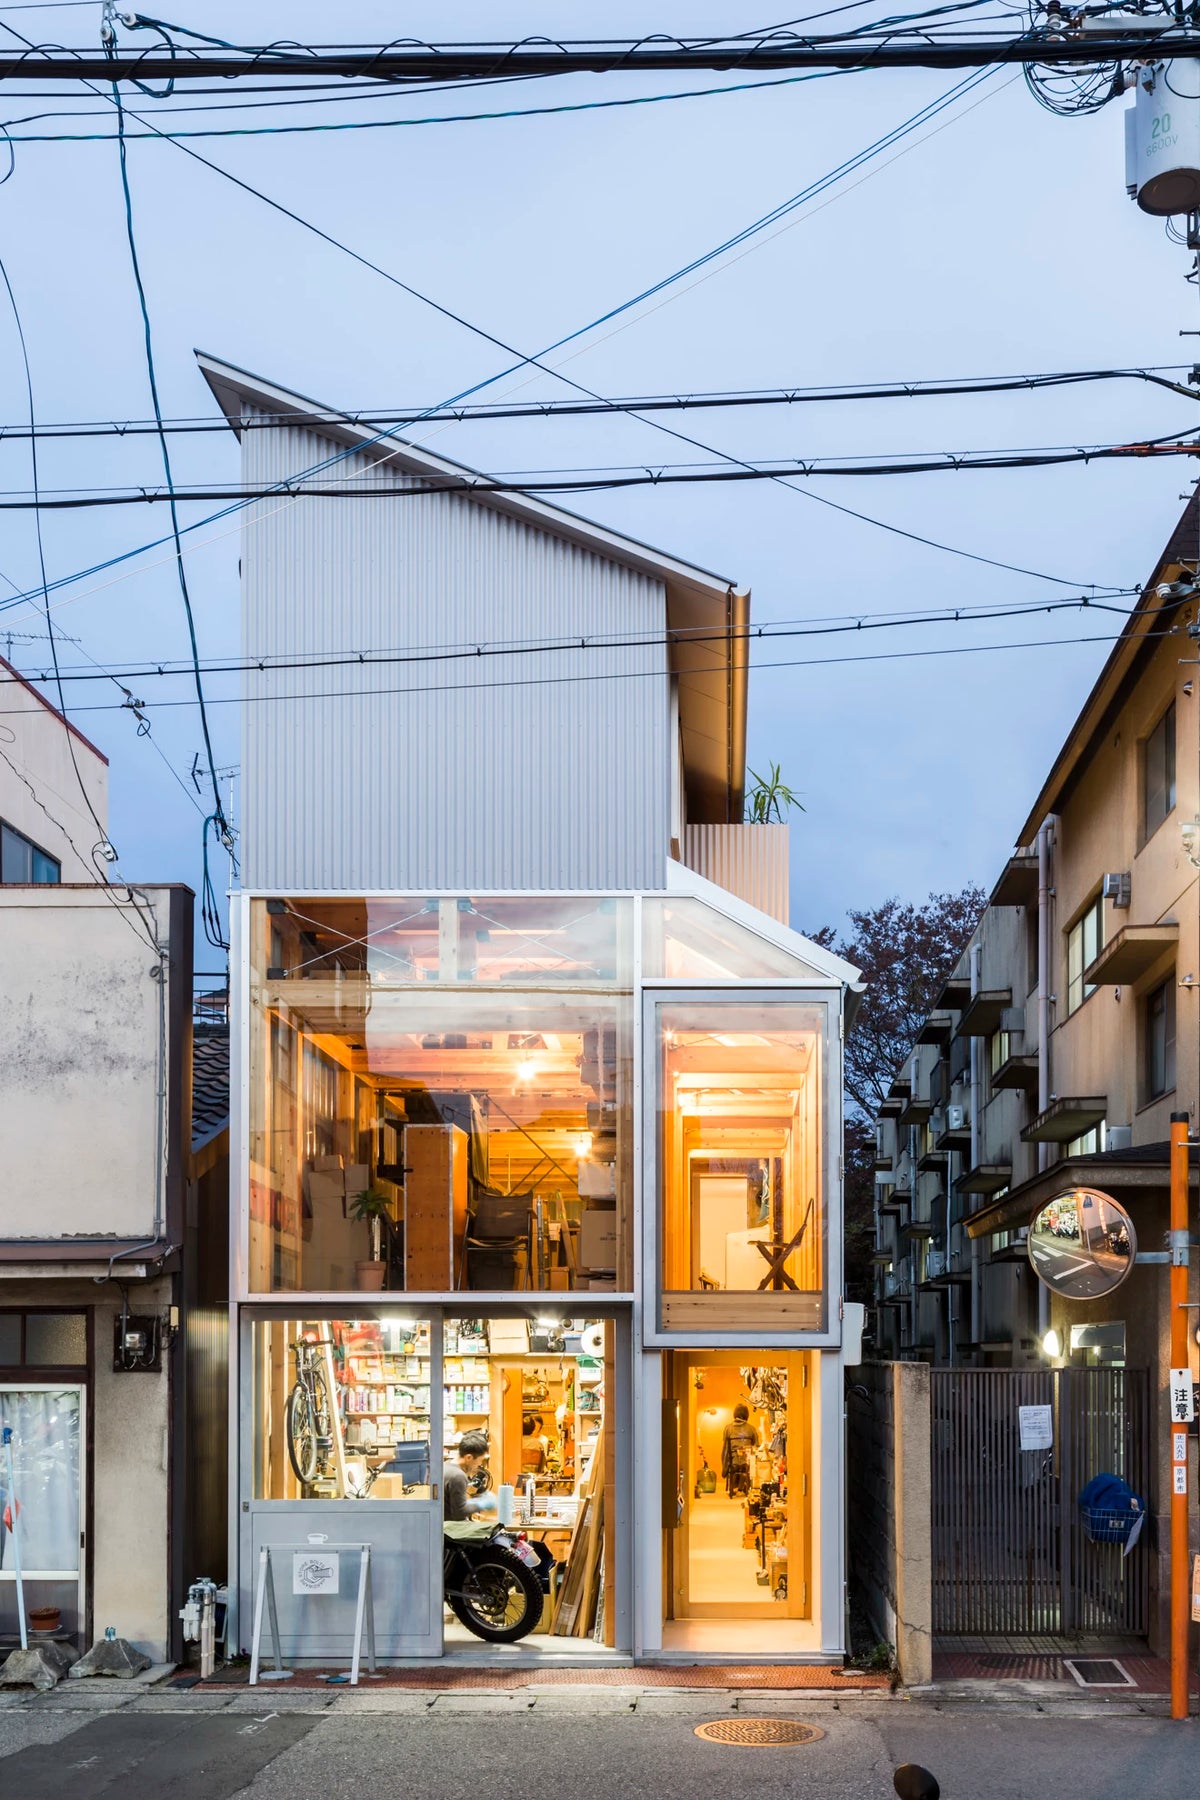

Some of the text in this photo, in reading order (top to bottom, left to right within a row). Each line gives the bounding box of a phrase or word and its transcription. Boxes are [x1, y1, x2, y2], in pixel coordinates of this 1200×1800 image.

[1152, 113, 1171, 139] 20
[1146, 135, 1178, 156] 6600V
[1174, 1388, 1189, 1417] 注意
[1176, 1468, 1184, 1492] 京都市
